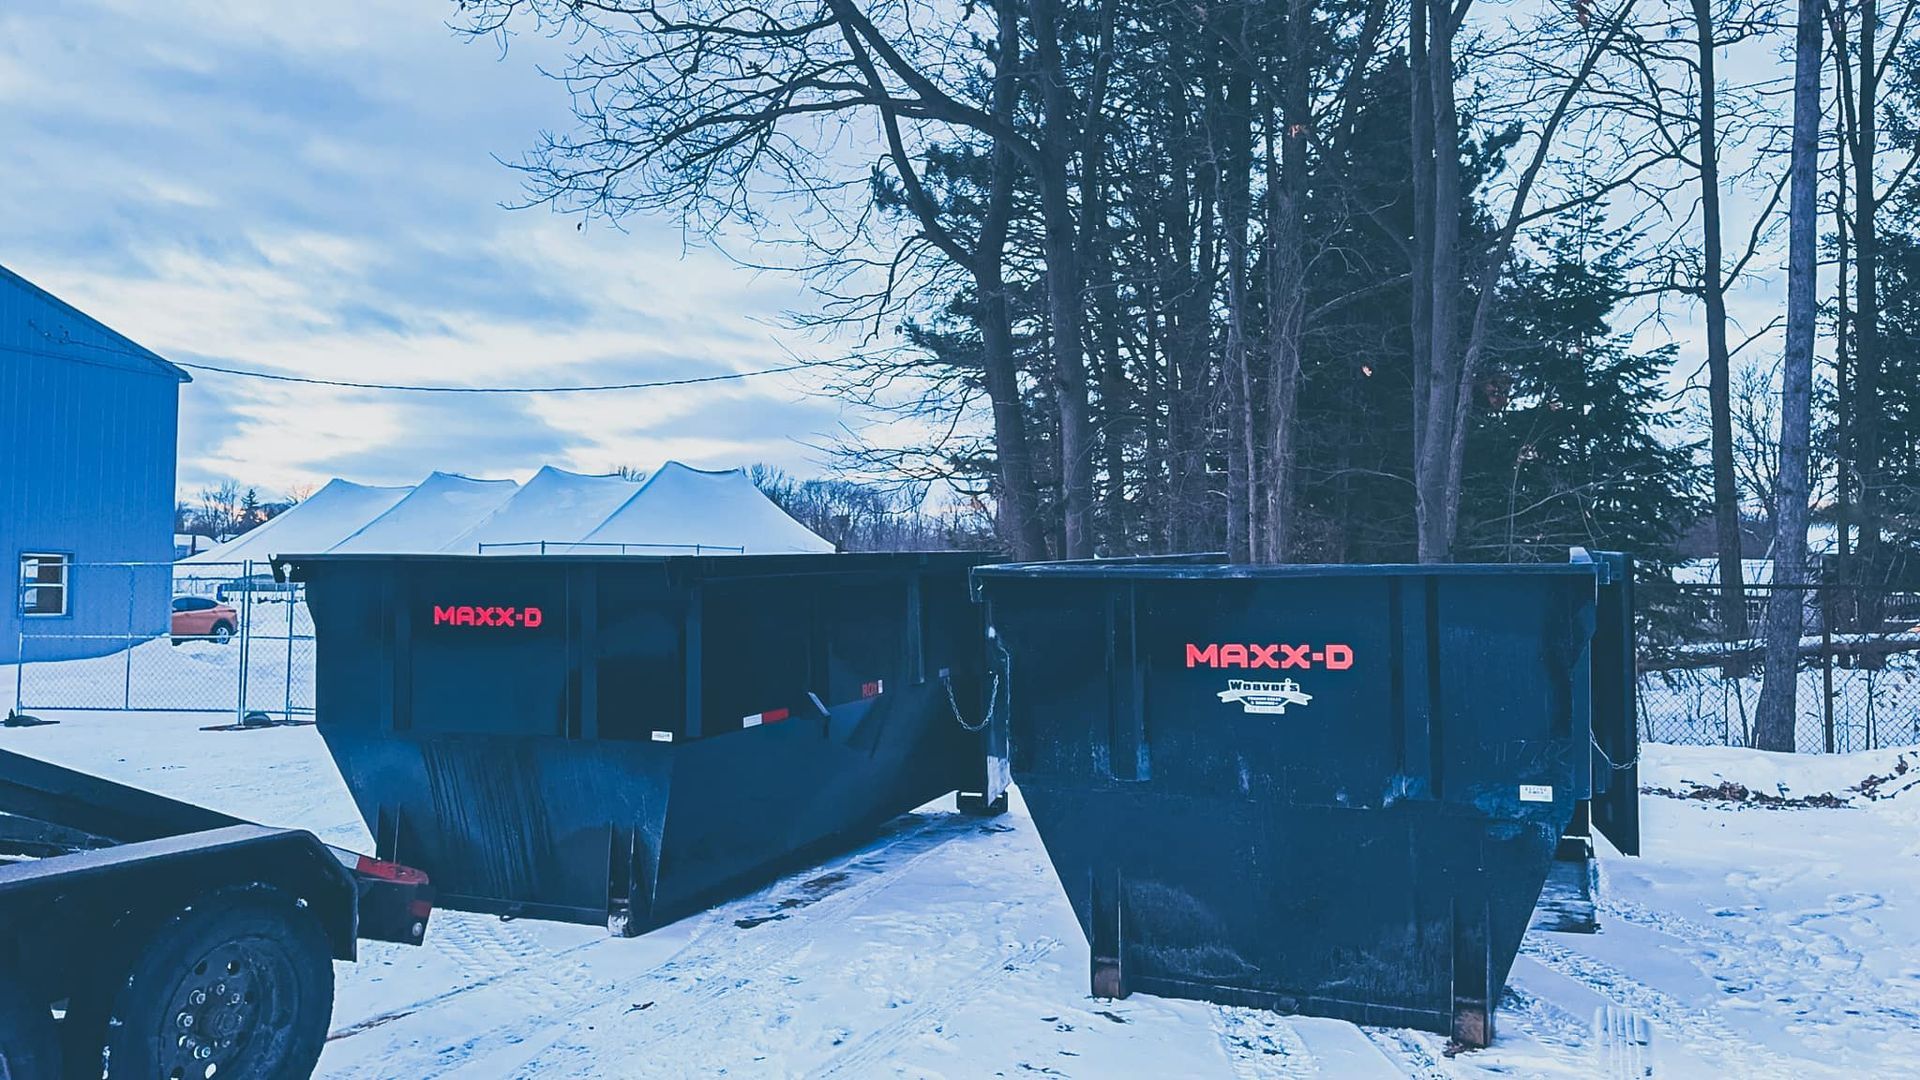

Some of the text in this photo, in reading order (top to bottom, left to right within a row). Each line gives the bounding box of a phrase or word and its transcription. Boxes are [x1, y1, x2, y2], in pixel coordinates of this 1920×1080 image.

[434, 605, 542, 628] MAXX-D
[1186, 643, 1354, 670] MAXX-D
[1229, 679, 1299, 692] Weaver's
